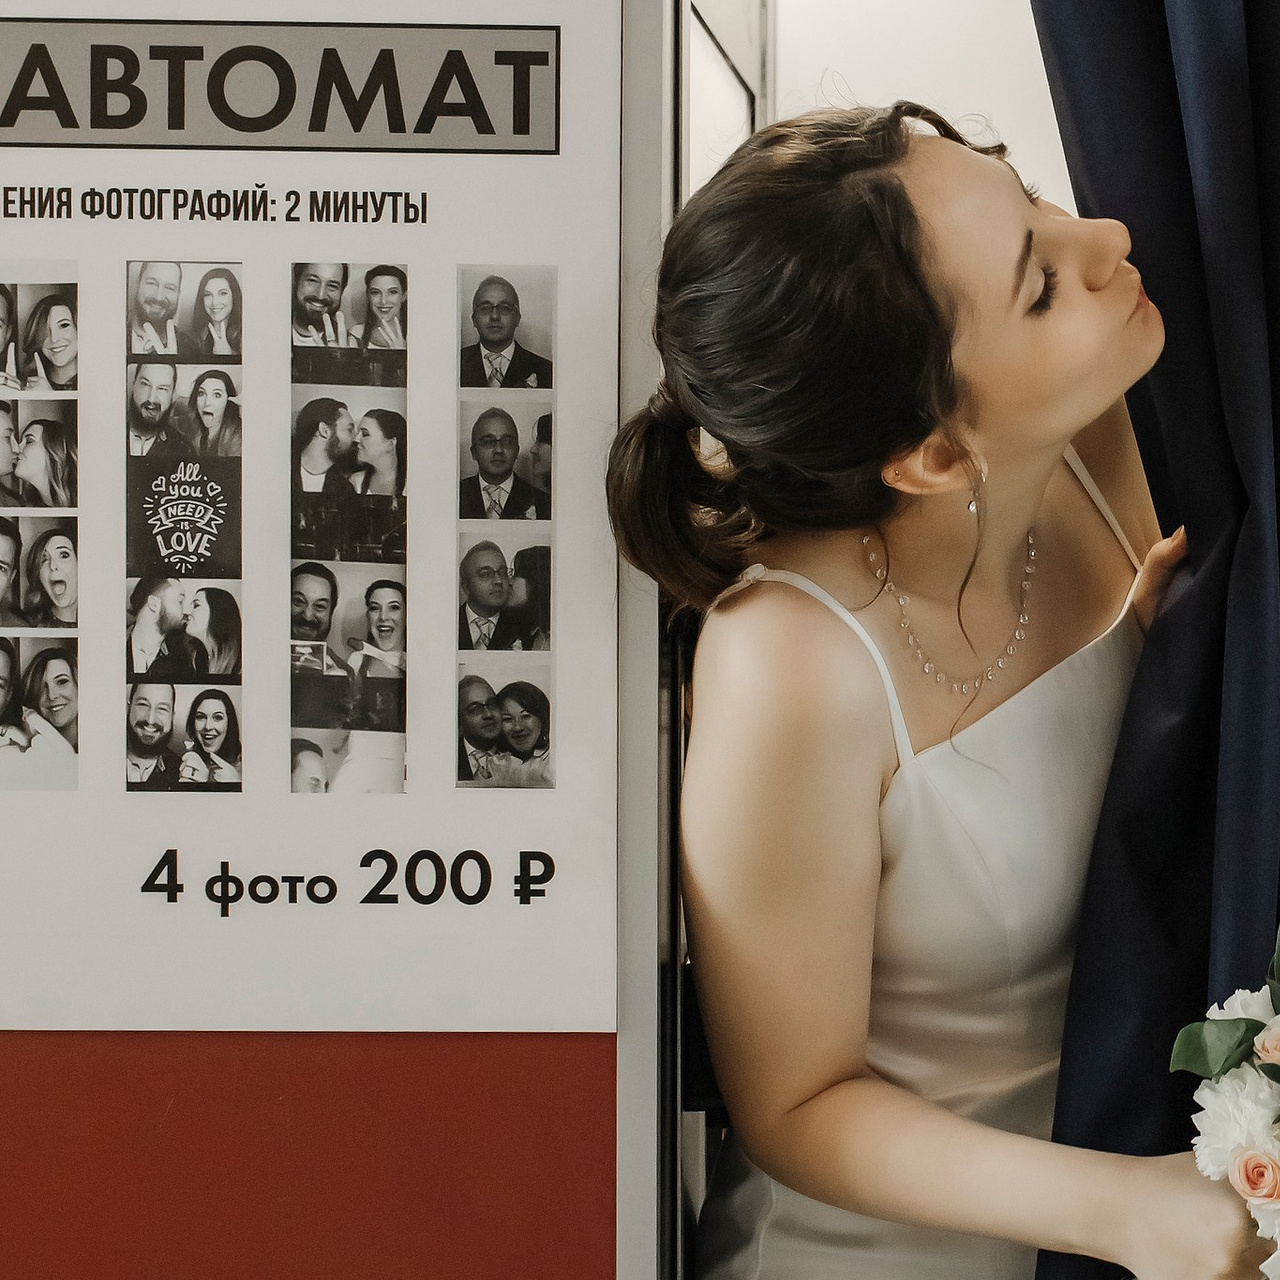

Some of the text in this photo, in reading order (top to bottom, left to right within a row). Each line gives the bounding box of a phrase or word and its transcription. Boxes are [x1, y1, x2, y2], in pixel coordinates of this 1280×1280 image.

[80, 182, 277, 222] ФОТОГРАФИЙ:
[285, 190, 301, 222] 2
[309, 190, 428, 224] МИНУТЫ
[170, 461, 202, 483] All
[161, 484, 203, 504] you
[167, 503, 205, 519] NEED
[156, 531, 217, 557] LOVE
[140, 848, 185, 903] 4
[205, 861, 338, 917] фото
[359, 849, 492, 905] 200
